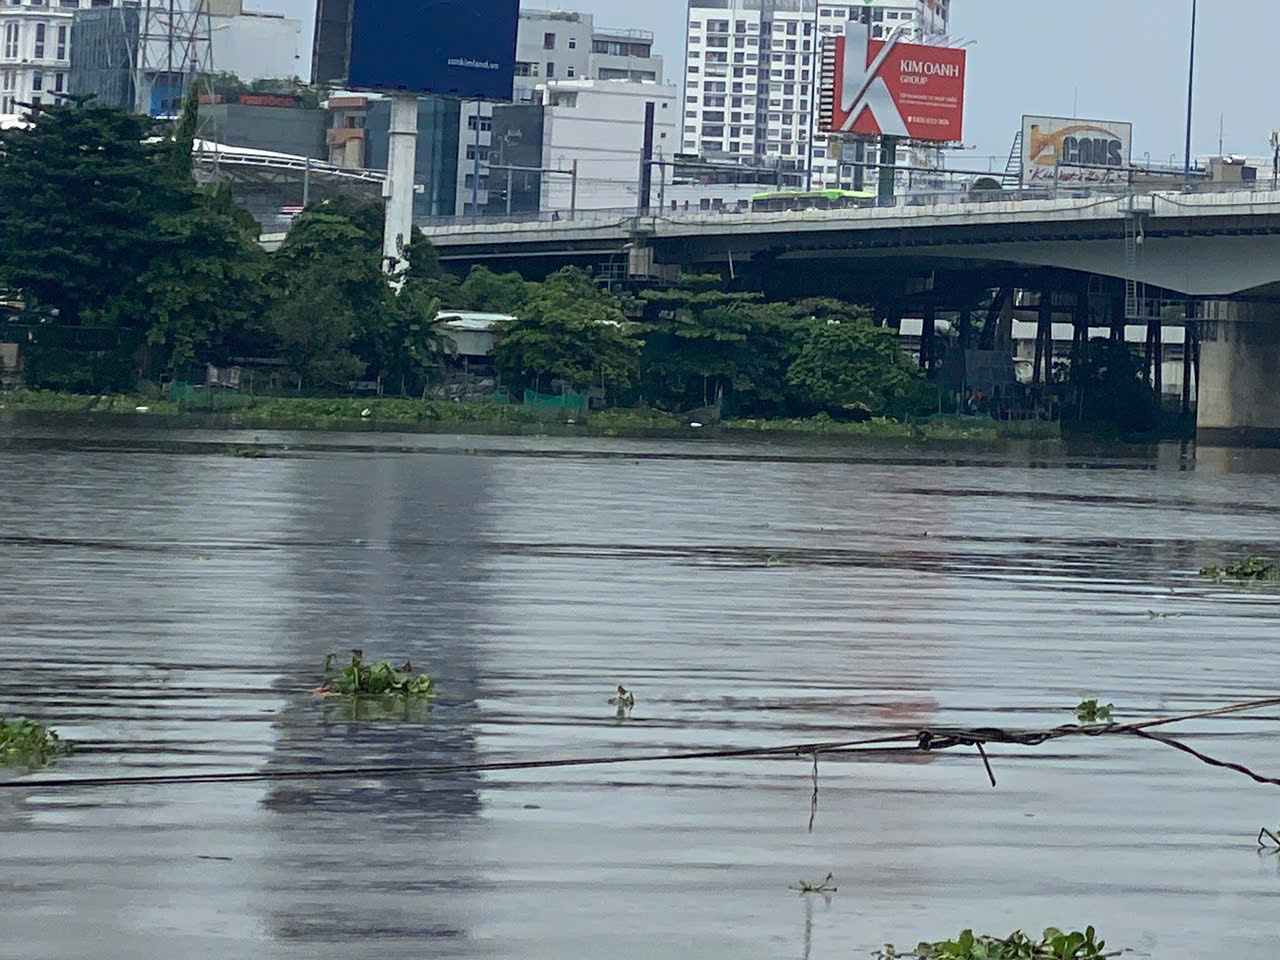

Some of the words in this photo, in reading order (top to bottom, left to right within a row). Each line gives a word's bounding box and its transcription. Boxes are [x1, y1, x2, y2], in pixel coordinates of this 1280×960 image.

[900, 59, 923, 74] KIM
[924, 61, 959, 78] OANH
[900, 74, 928, 85] GROUP
